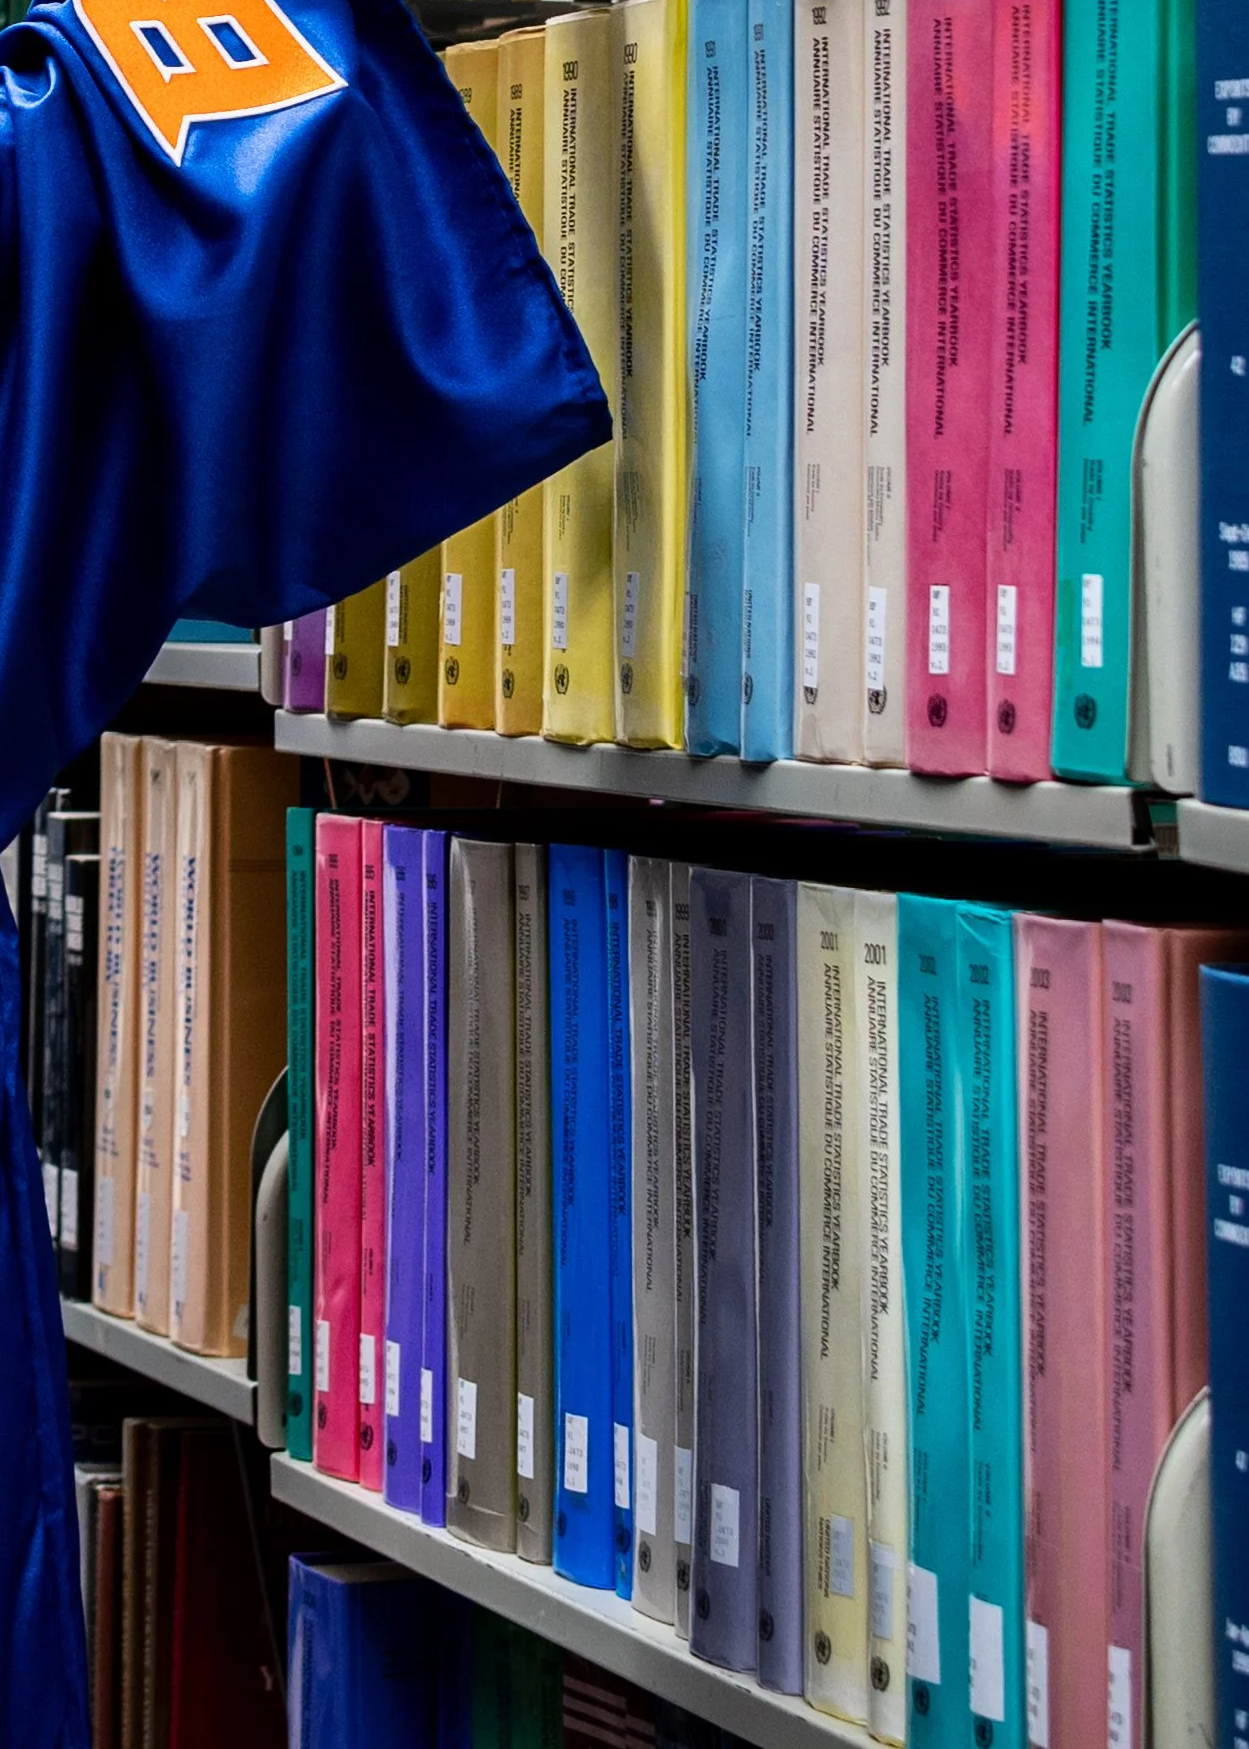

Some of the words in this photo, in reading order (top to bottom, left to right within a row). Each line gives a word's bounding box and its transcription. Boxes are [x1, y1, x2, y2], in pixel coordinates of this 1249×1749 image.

[623, 42, 638, 65] 1990
[811, 7, 827, 25] 1992
[812, 37, 821, 112] ANNUAIRE
[821, 36, 830, 150] INTERNATIONAL
[874, 29, 882, 105] ANNUAIRE
[882, 28, 891, 144] INTERNATIONAL
[933, 18, 943, 96] ANNUAIRE
[943, 17, 954, 135] INTERNATIONAL
[812, 115, 821, 207] STATISTIQUE
[822, 155, 830, 200] TRADE
[873, 109, 882, 202] STATISTIQUE
[882, 150, 891, 196] TRADE
[934, 101, 946, 196] STATISTIQUE
[948, 142, 957, 192] TRADE
[812, 211, 821, 232] DU
[819, 207, 828, 287] STATISTICS
[873, 207, 881, 228] DU
[882, 203, 891, 286] STATISTICS
[937, 201, 948, 223] DU
[949, 197, 959, 282] STATISTICS
[810, 235, 820, 316] COMMERCE
[872, 232, 881, 316] COMMERCE
[937, 227, 948, 316] COMMERCE
[817, 290, 827, 367] YEARBOOK
[881, 289, 890, 367] YEARBOOK
[949, 285, 958, 368] YEARBOOK
[806, 321, 818, 436] INTERNATIONAL
[870, 320, 880, 438] INTERNATIONAL
[934, 321, 947, 440] INTERNATIONAL
[820, 930, 839, 952] 2001
[863, 942, 887, 965] 2001
[823, 962, 833, 1039] ANNUAIRE
[832, 964, 843, 1078] INTERNATIONAL
[866, 975, 877, 1053] ANNUAIRE
[876, 980, 887, 1095] INTERNATIONAL
[824, 1041, 833, 1131] STATISTIQUE
[833, 1081, 842, 1129] TRADE
[868, 1055, 878, 1146] STATISTIQUE
[878, 1101, 888, 1150] TRADE
[823, 1132, 833, 1153] DU
[832, 1132, 842, 1213] STATISTICS
[869, 1150, 878, 1172] DU
[821, 1157, 833, 1243] COMMERCE
[870, 1174, 879, 1263] COMMERCE
[878, 1153, 888, 1234] STATISTICS
[830, 1214, 841, 1293] YEARBOOK
[879, 1238, 889, 1316] YEARBOOK
[819, 1245, 831, 1361] INTERNATIONAL
[870, 1265, 880, 1385] INTERNATIONAL
